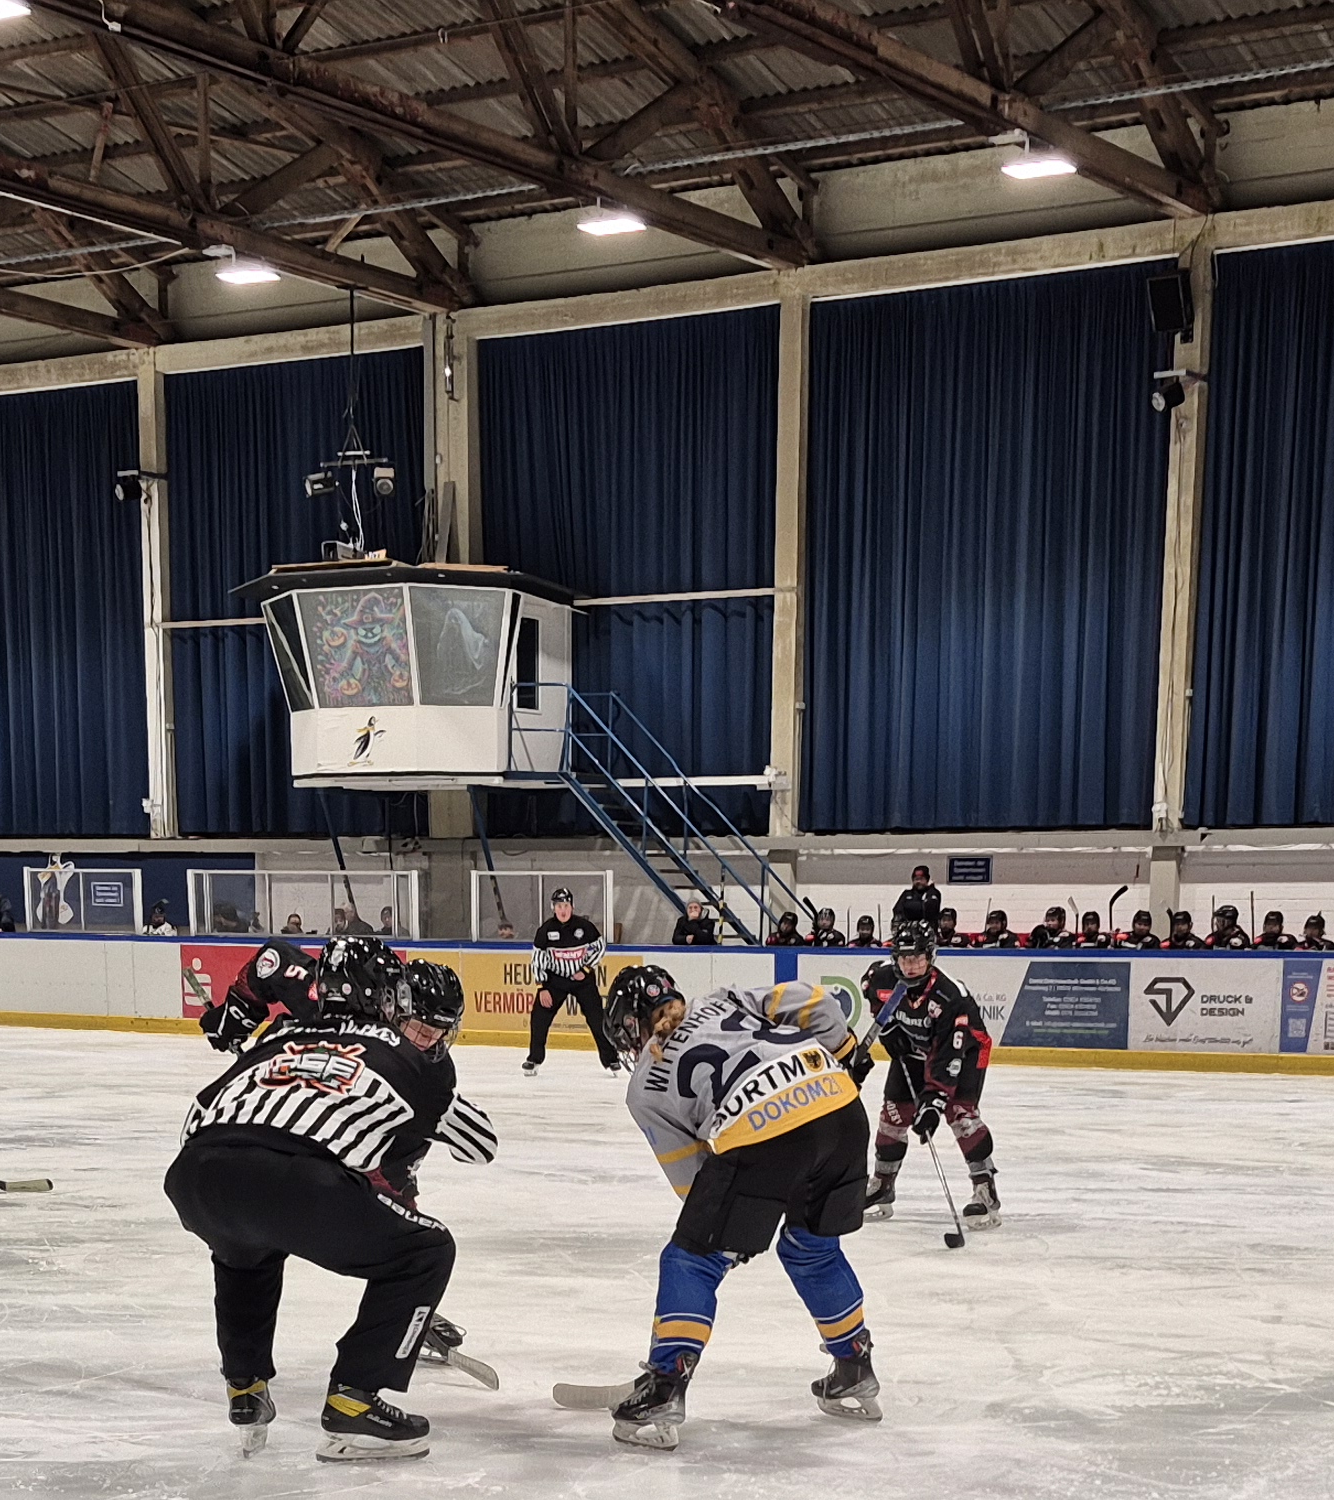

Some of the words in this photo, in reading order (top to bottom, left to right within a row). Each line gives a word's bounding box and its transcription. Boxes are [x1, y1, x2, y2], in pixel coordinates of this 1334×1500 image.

[1200, 994, 1243, 1004] DRUCK
[1200, 1007, 1245, 1017] DESIGN
[952, 1030, 965, 1050] 6
